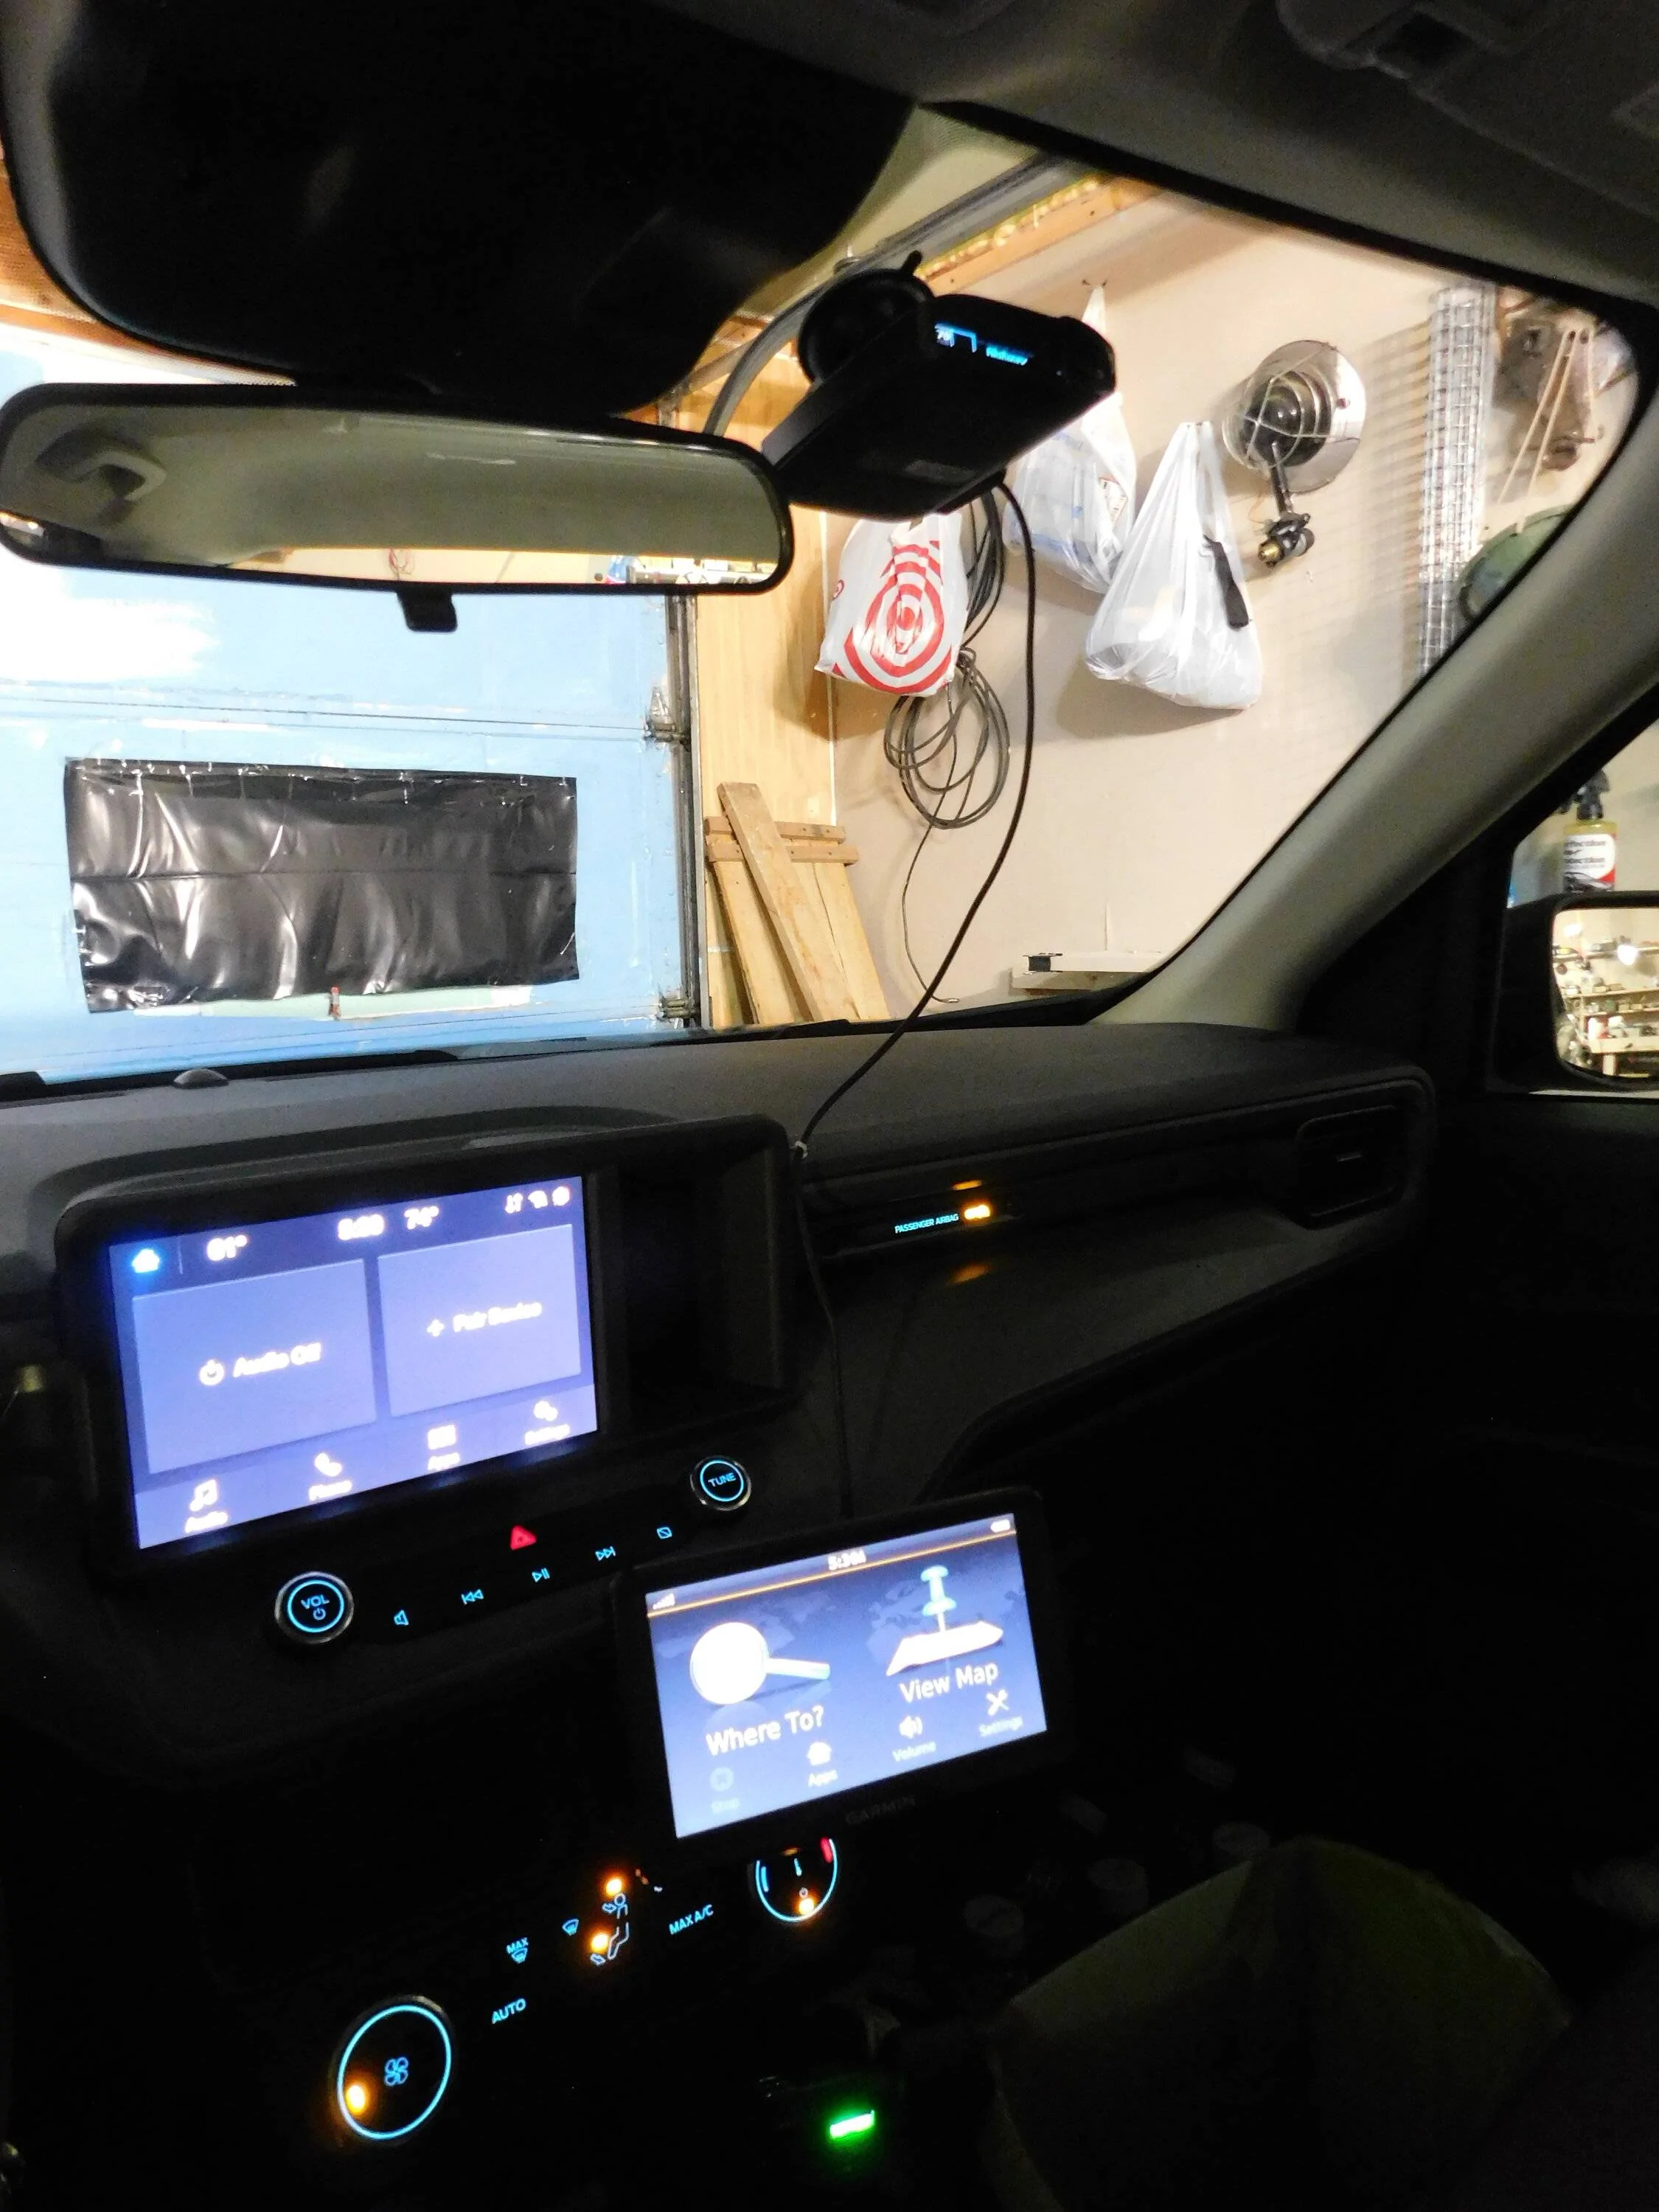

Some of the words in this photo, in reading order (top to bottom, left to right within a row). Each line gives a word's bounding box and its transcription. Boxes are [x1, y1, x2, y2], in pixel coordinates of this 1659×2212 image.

[894, 1218, 934, 1234] PASSENGER
[935, 1213, 959, 1225] AIRBAG
[708, 1472, 737, 1487] TUNE
[300, 1594, 330, 1610] VOL
[899, 1674, 950, 1703] View
[955, 1663, 998, 1689] Map
[705, 1726, 782, 1757] Where
[784, 1704, 824, 1734] To?
[891, 1741, 937, 1762] Volume
[669, 1914, 694, 1935] MAX
[695, 1904, 714, 1923] A/C
[506, 1937, 529, 1954] MAX
[492, 1998, 526, 2025] AUTO
